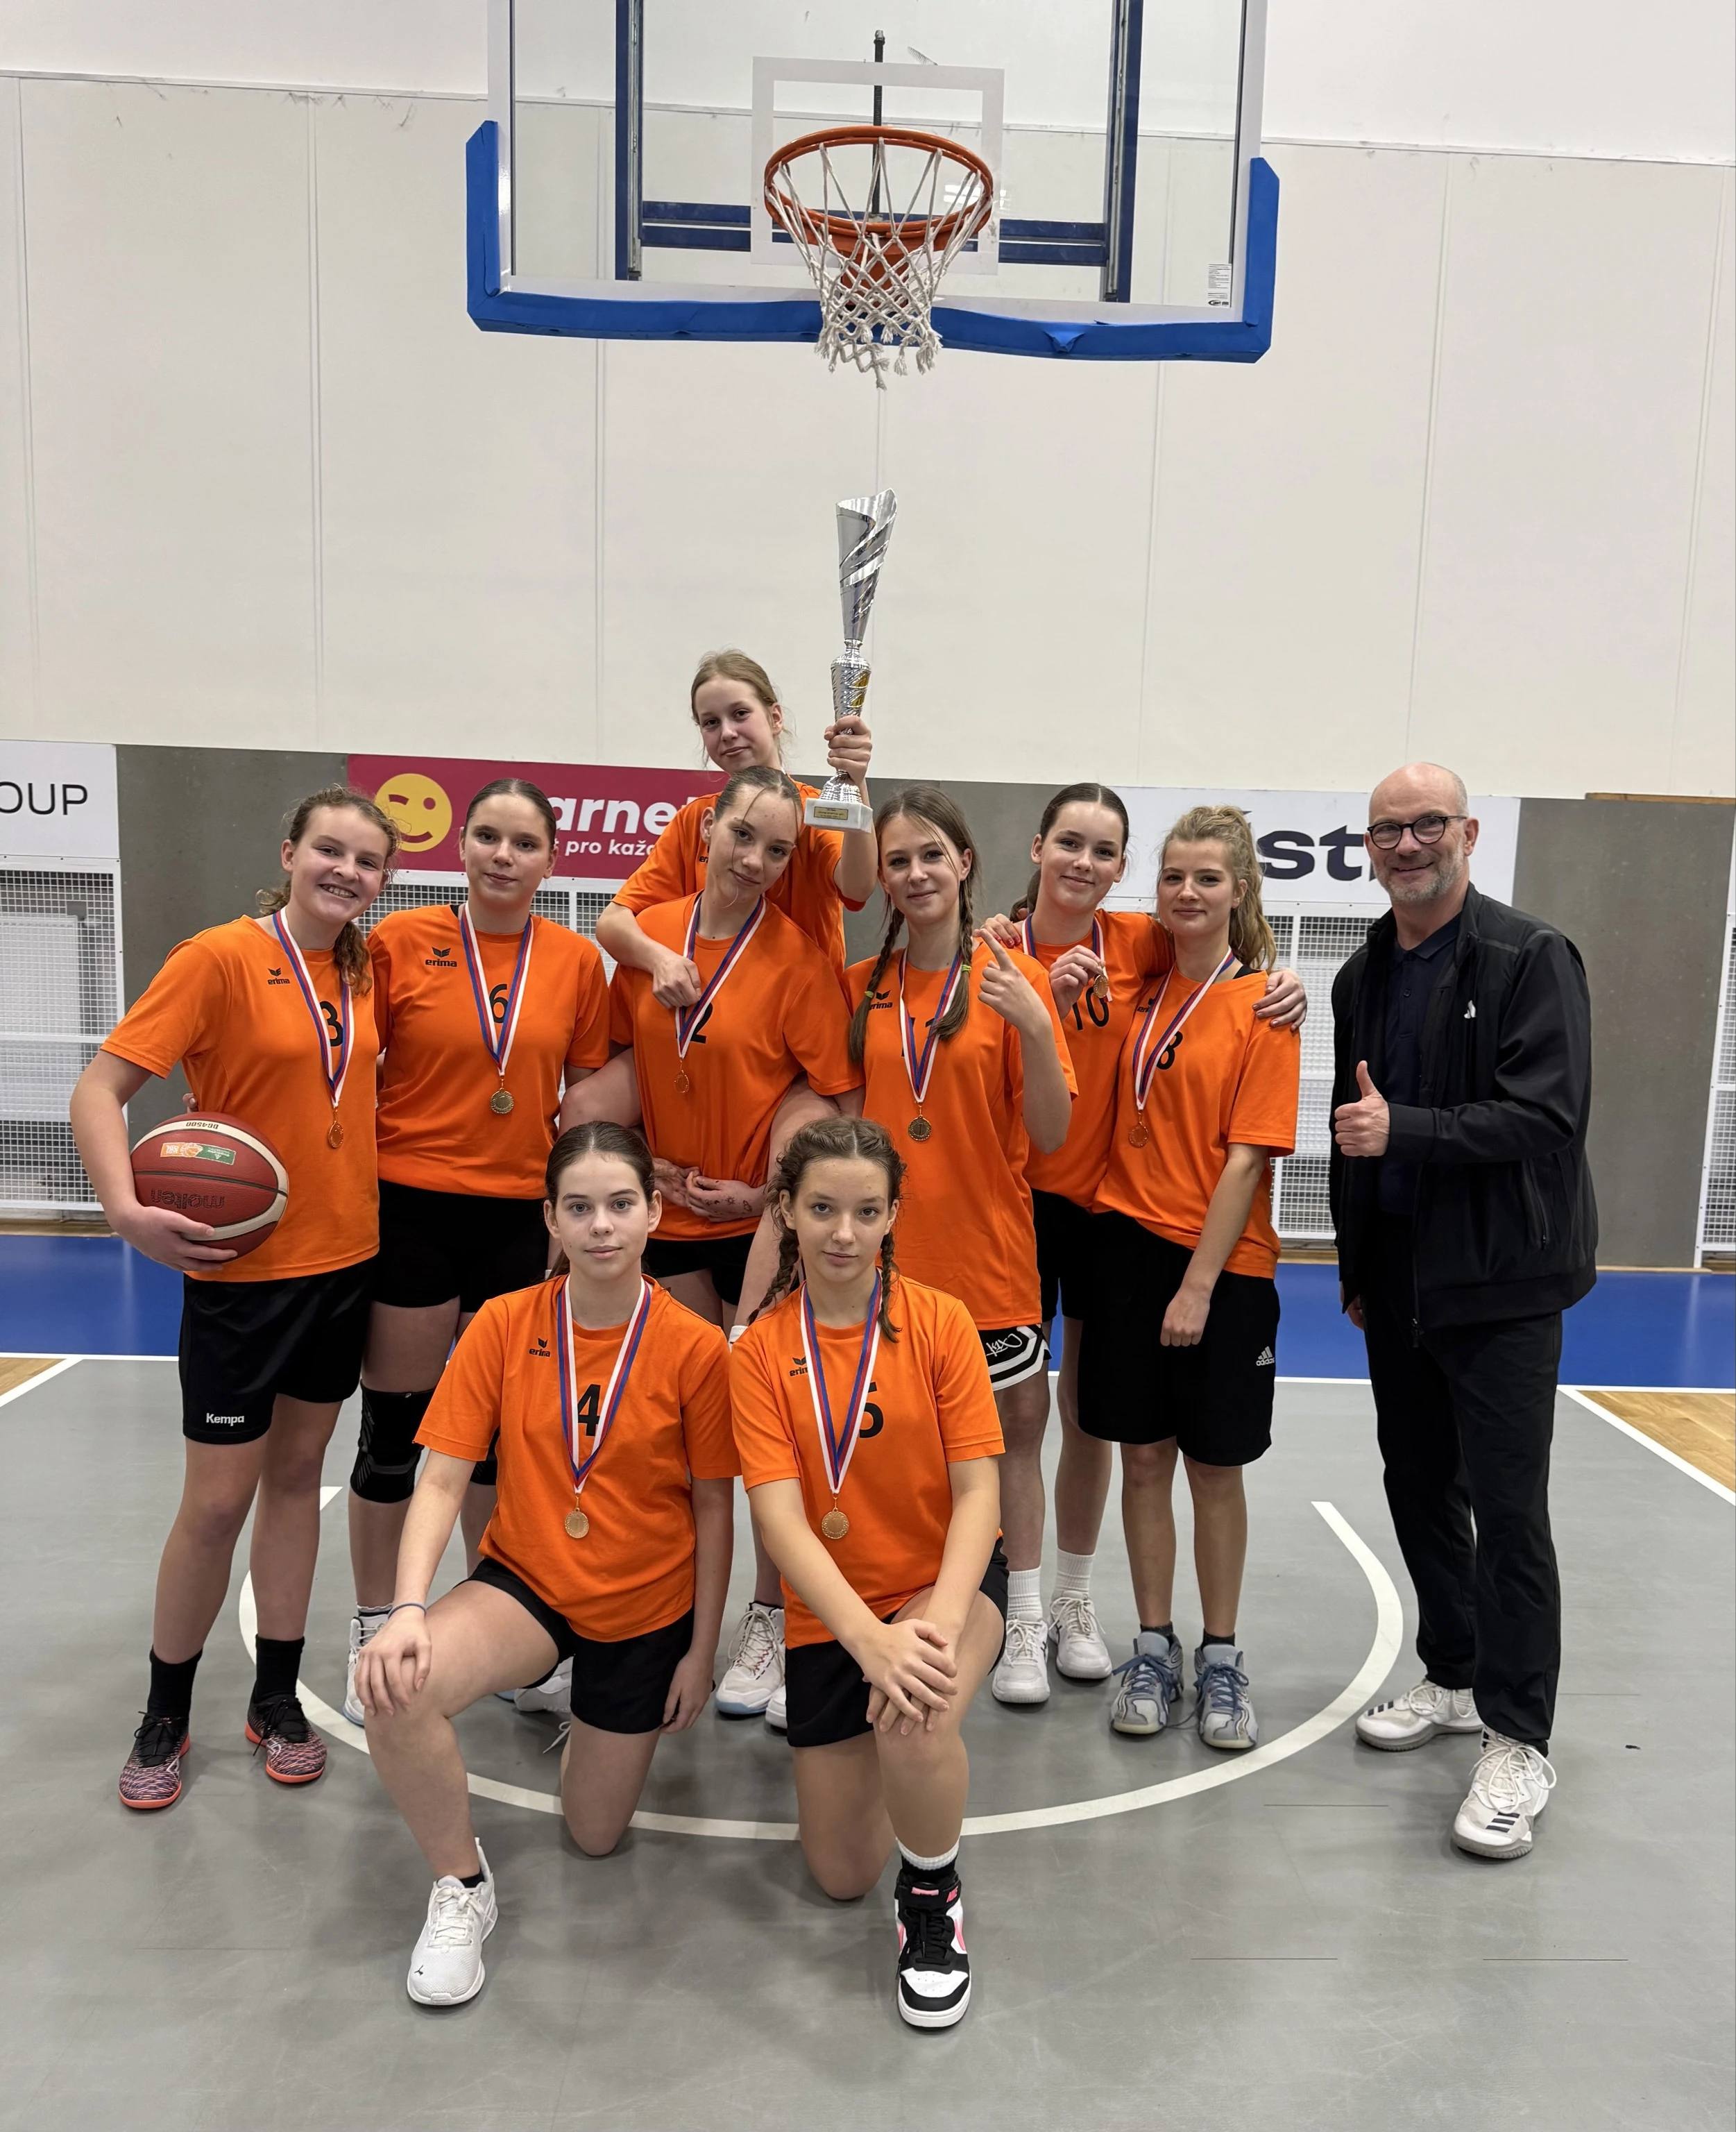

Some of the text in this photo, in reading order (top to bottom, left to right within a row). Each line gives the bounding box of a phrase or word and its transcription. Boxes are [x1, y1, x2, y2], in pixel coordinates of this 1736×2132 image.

[0, 781, 88, 815] OUP
[547, 797, 698, 836] arne
[565, 840, 602, 856] pro
[1257, 824, 1377, 881] st
[425, 958, 457, 967] erima
[489, 983, 509, 1024] 6
[1072, 985, 1109, 1031] 10
[319, 1001, 343, 1047] 3
[1156, 1031, 1184, 1070] 8
[151, 1189, 225, 1209] molten
[206, 1412, 245, 1427] Kempa
[577, 1384, 601, 1437] 4
